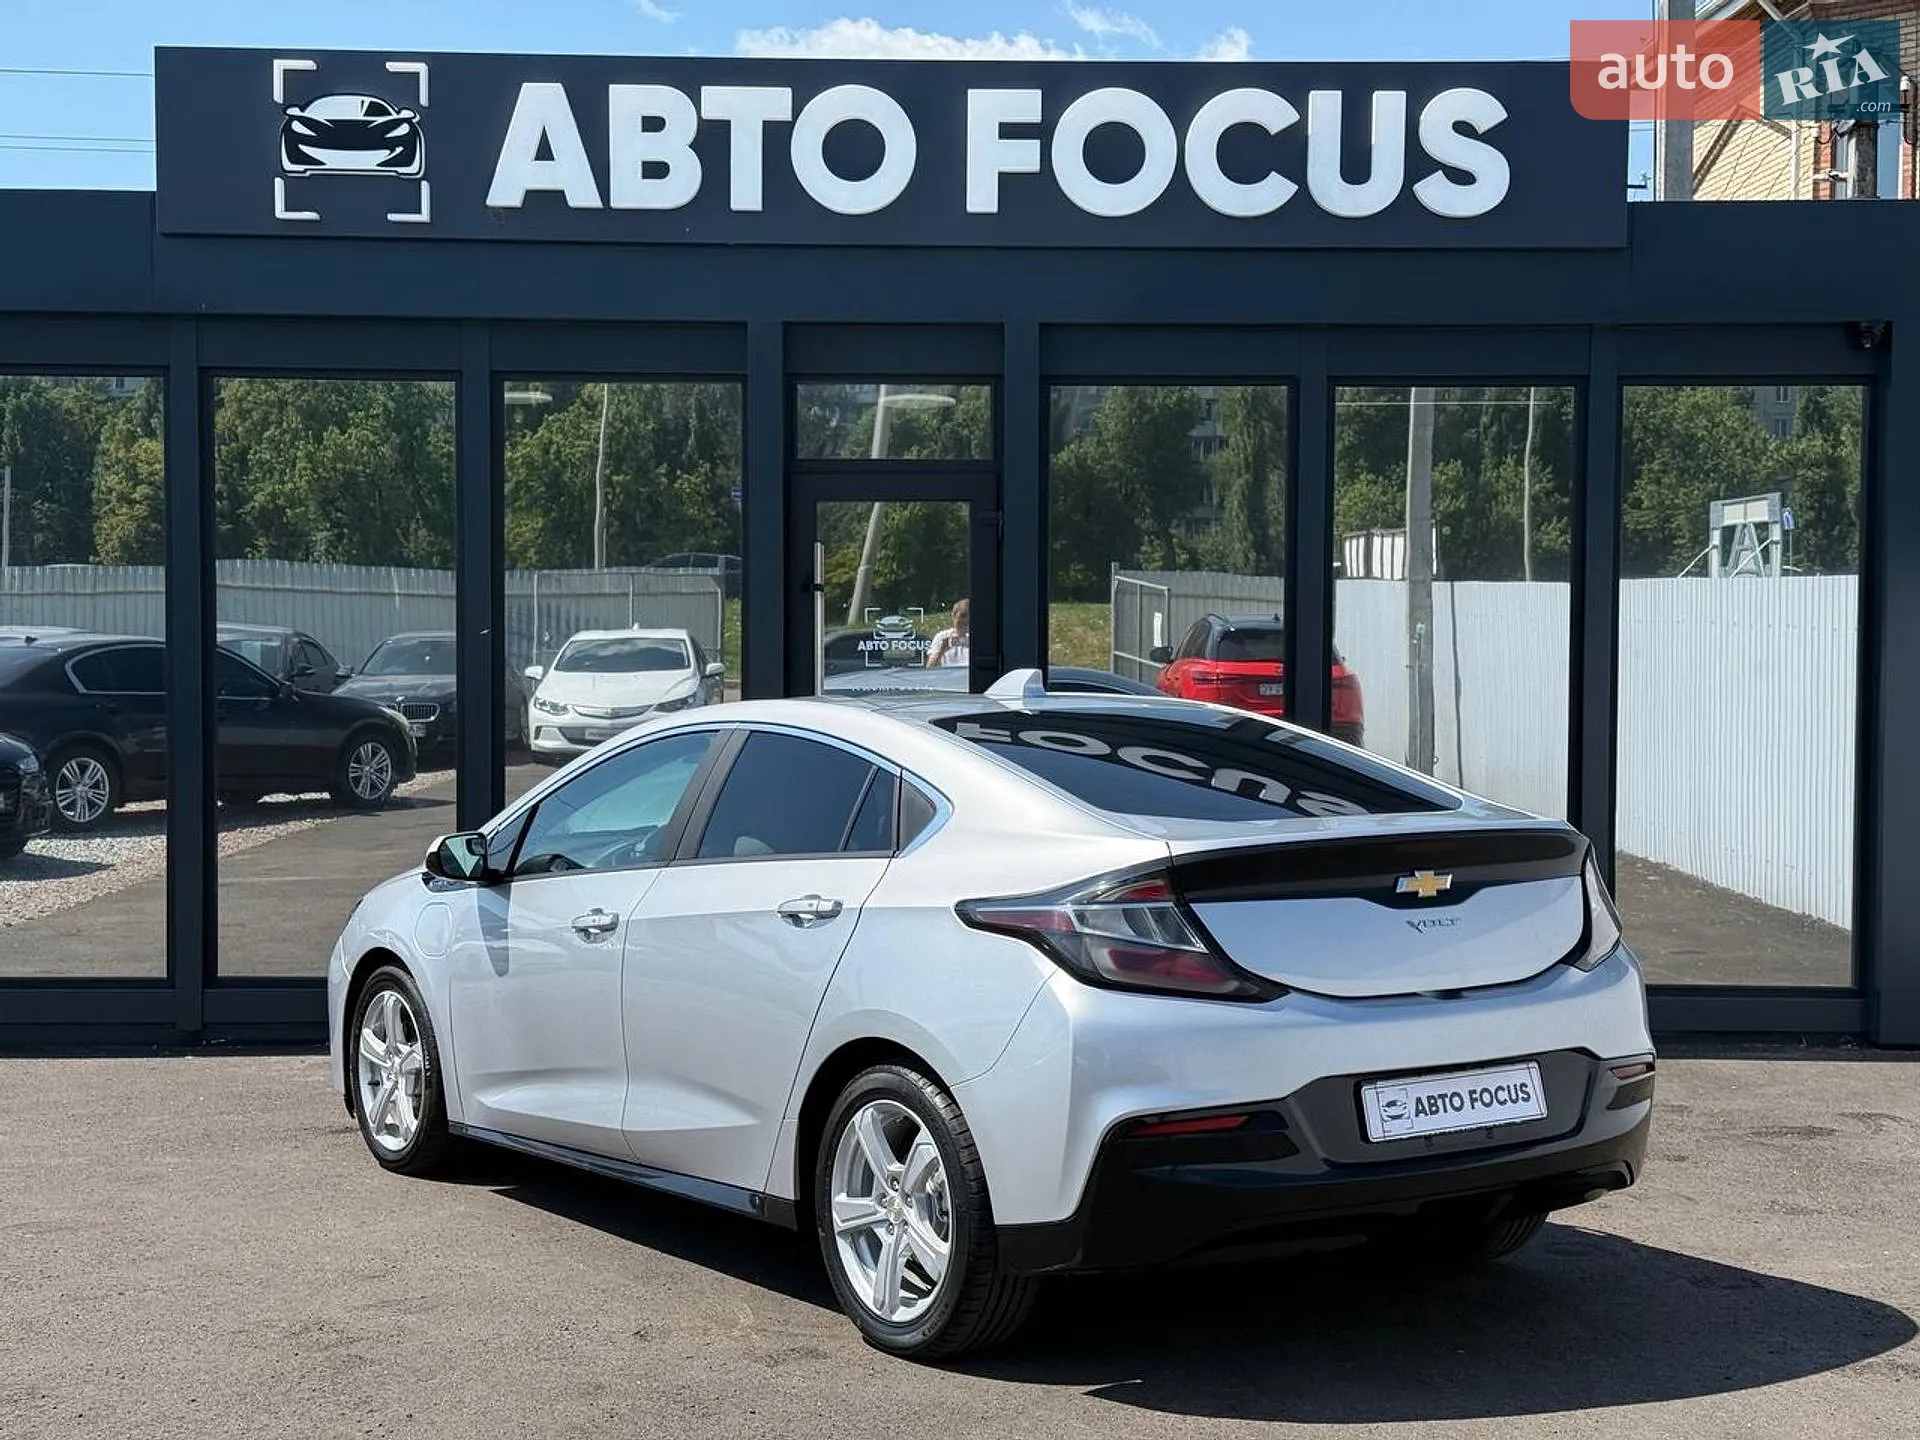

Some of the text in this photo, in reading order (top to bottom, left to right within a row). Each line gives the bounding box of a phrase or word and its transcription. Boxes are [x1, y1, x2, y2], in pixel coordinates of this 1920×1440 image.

[486, 82, 1511, 218] АВТО FOCUS
[892, 640, 932, 652] FOCUS
[1415, 1082, 1532, 1117] АВТО FOCUS
